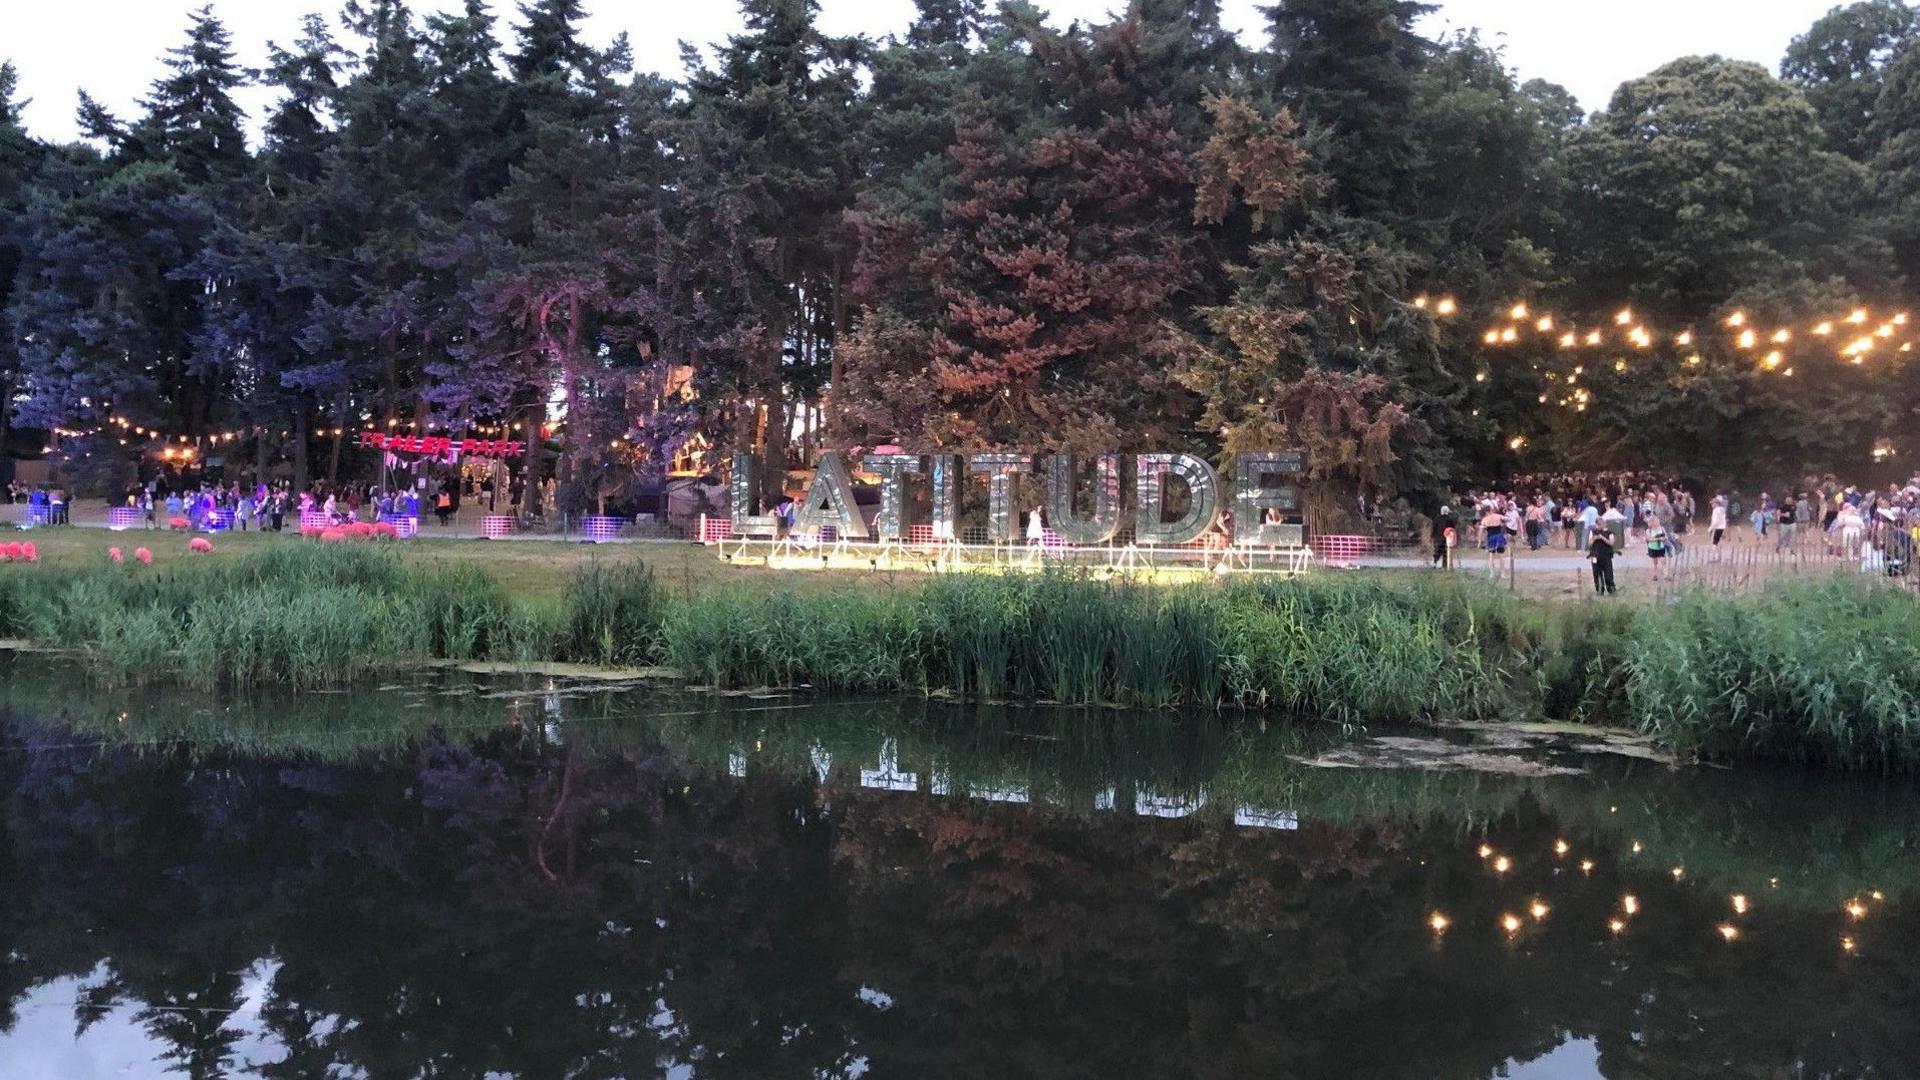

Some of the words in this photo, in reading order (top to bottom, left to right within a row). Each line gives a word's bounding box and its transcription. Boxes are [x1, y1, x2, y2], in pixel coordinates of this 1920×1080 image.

[360, 431, 452, 454] TRAILER
[460, 438, 524, 457] PARK
[731, 453, 1304, 546] LATITUDE
